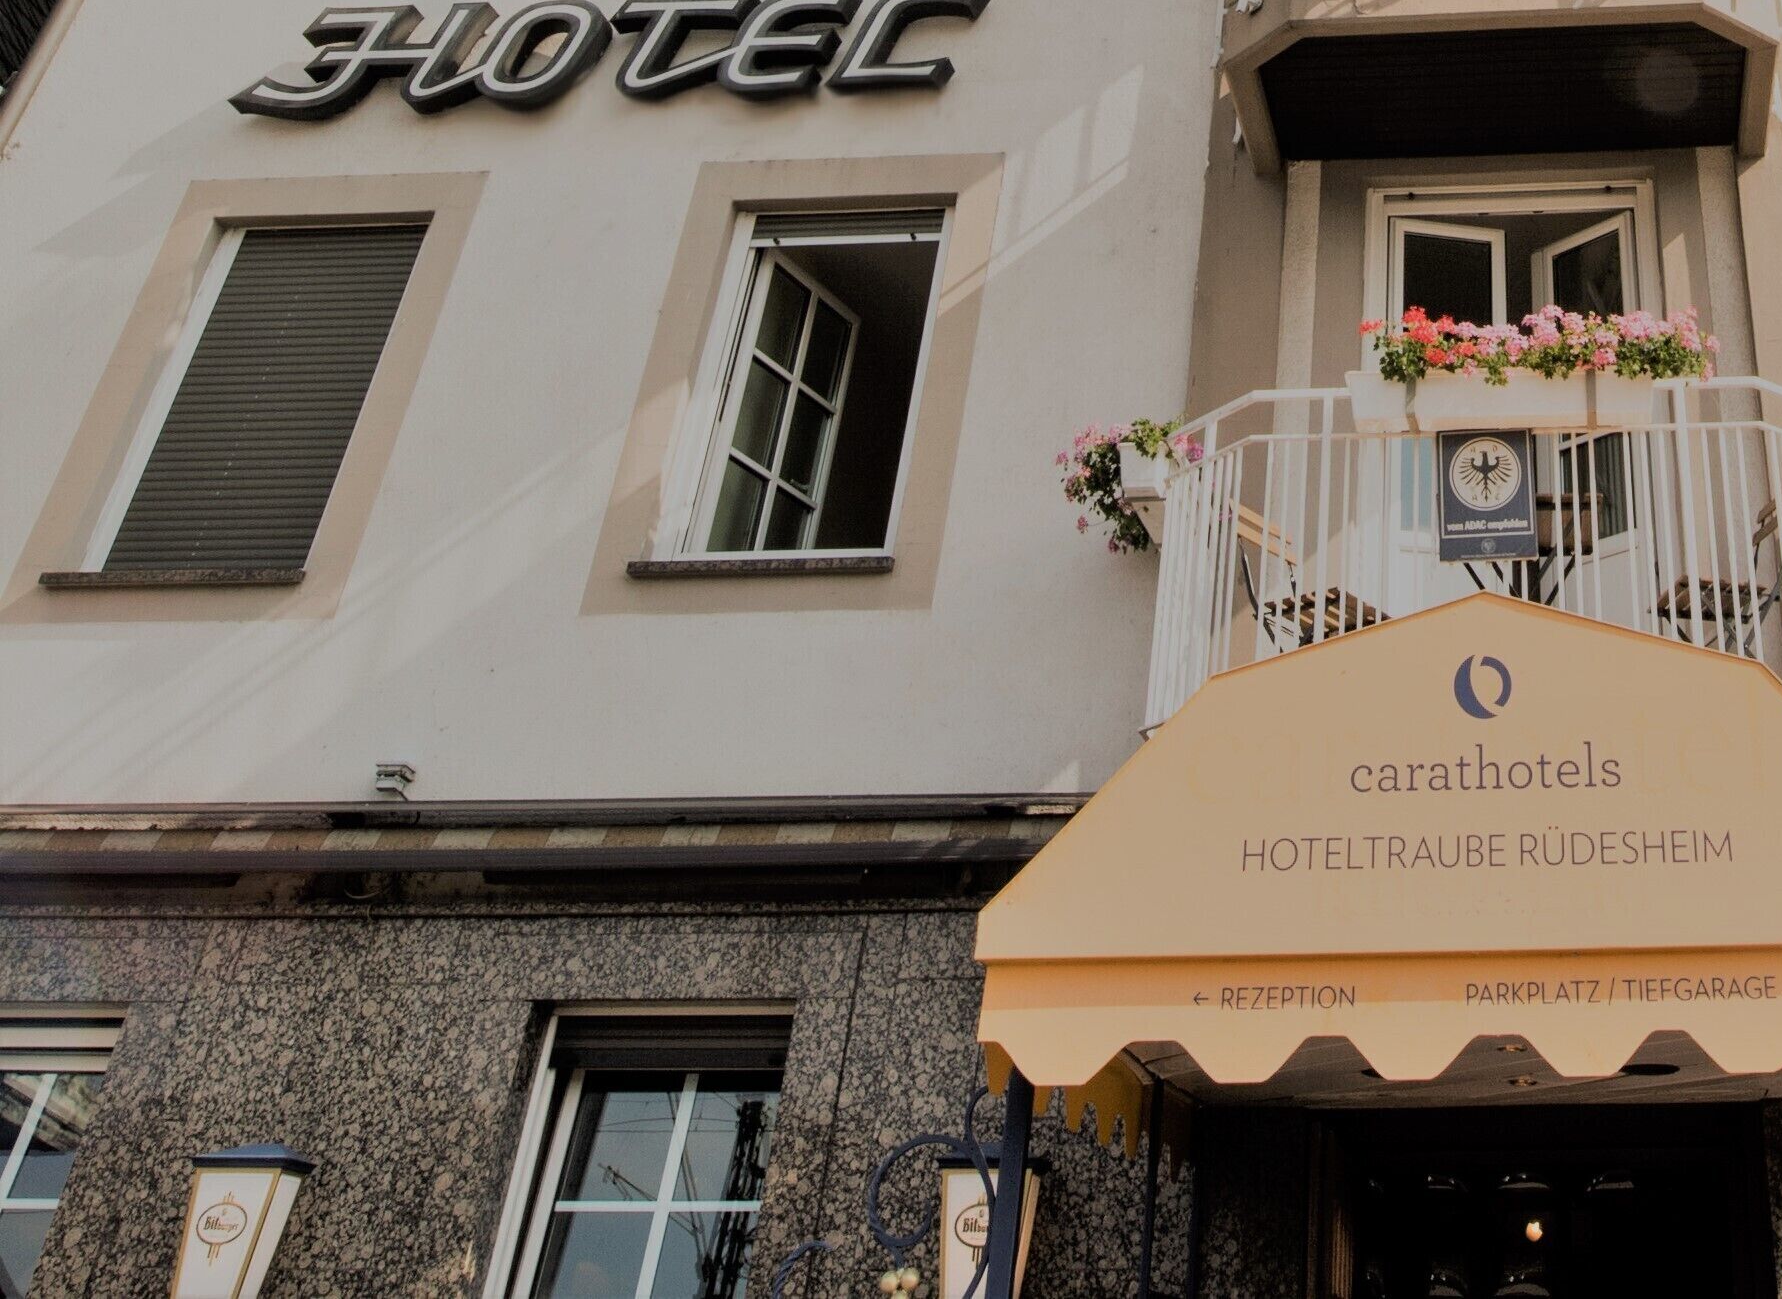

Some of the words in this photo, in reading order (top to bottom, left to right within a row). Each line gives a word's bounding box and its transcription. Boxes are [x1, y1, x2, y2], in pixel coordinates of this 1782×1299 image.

[1464, 519, 1487, 530] ADAC
[1350, 740, 1622, 793] carathotels
[1241, 832, 1507, 872] HOTELTRAUBE
[1518, 825, 1734, 867] RÜDESHEIM
[1220, 985, 1356, 1010] REZEPTION
[1466, 979, 1601, 1006] PARKPLATZ
[1621, 975, 1777, 1002] TIEFGARAGE
